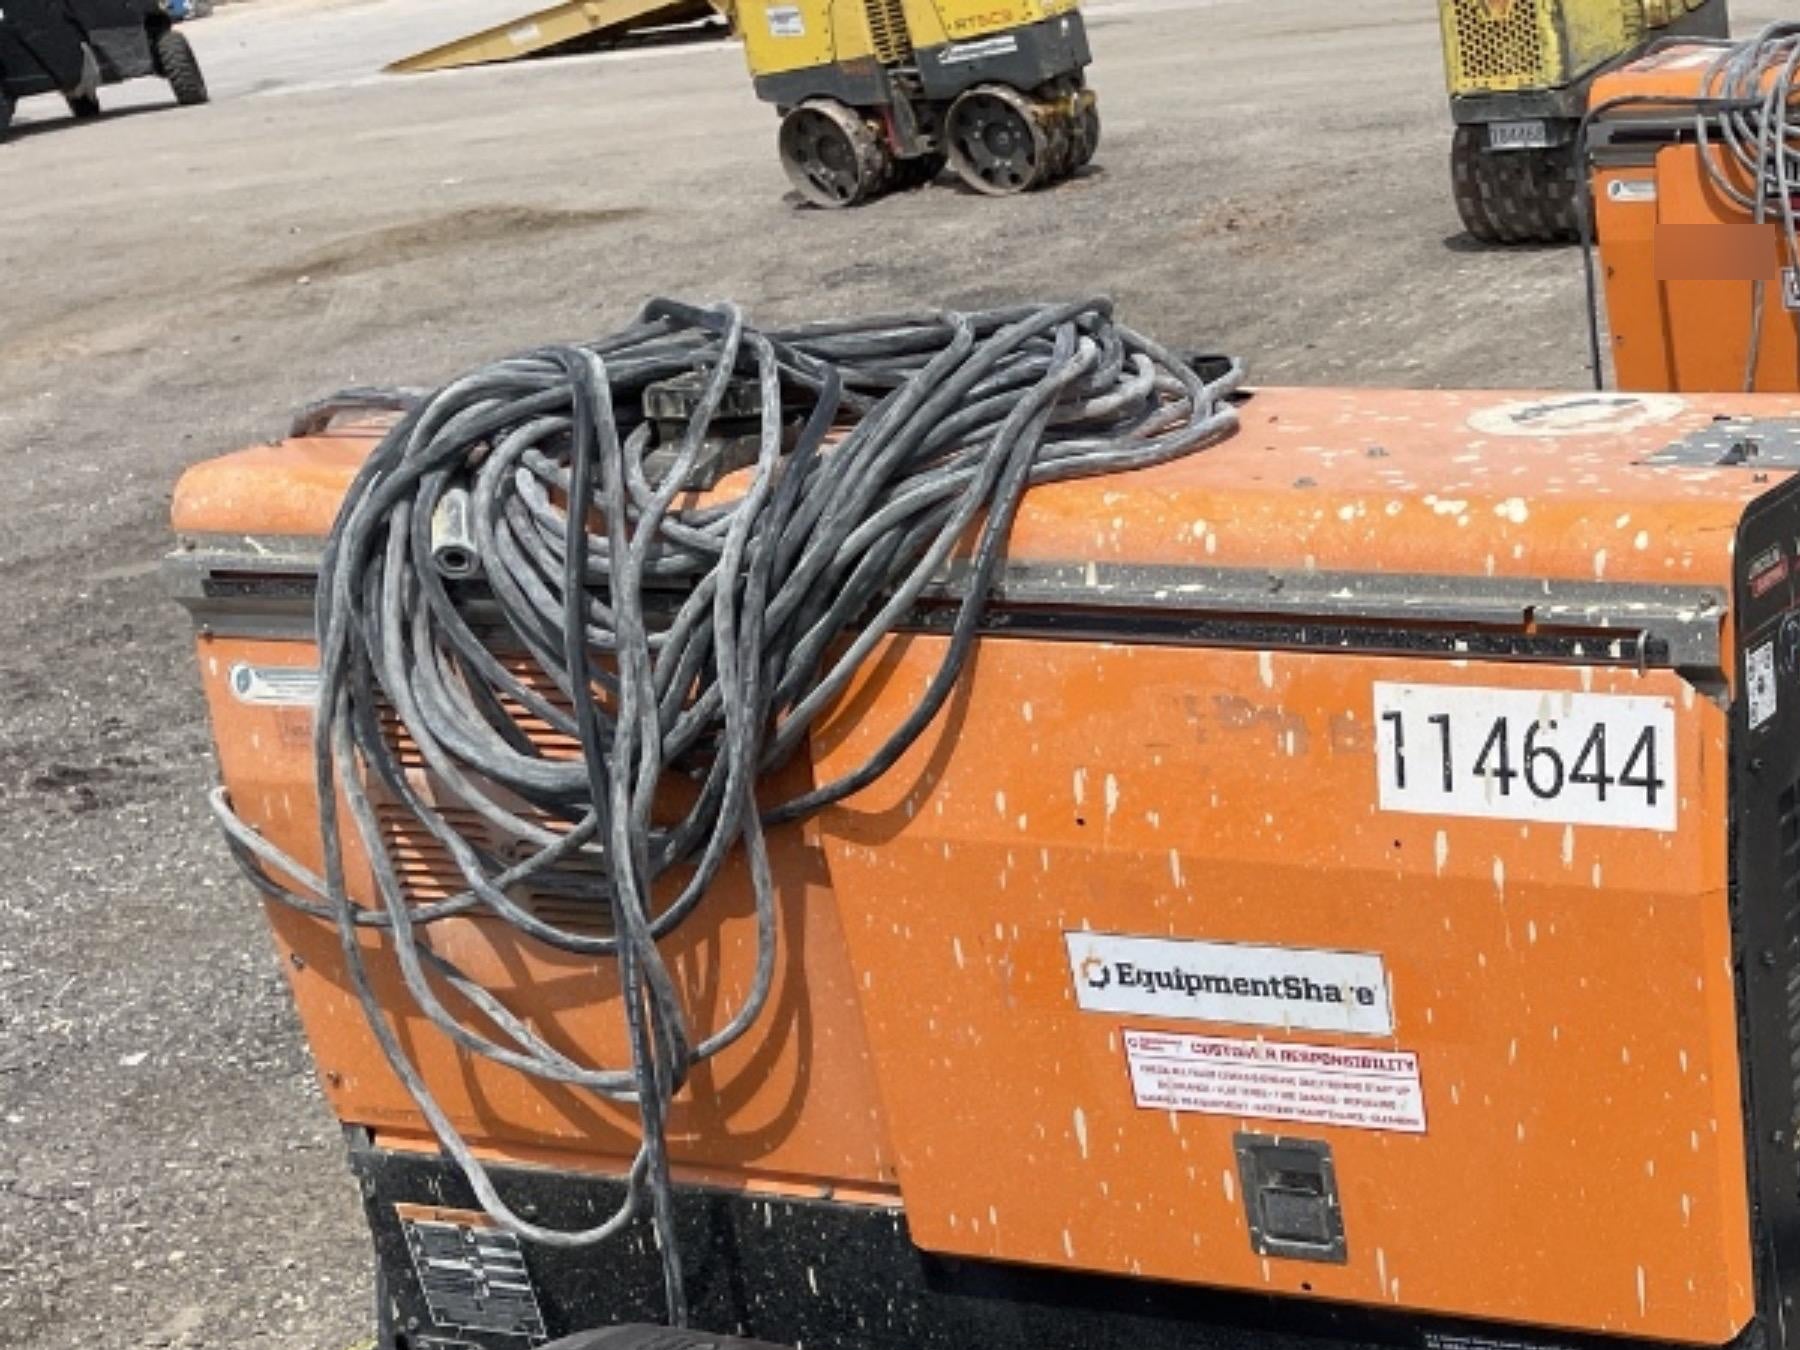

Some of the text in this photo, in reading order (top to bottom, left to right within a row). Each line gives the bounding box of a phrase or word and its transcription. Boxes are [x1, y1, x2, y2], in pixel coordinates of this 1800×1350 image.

[1381, 710, 1665, 806] 114644
[1115, 962, 1376, 1006] EquipmentShae
[1191, 1041, 1277, 1063] CUSTOMR
